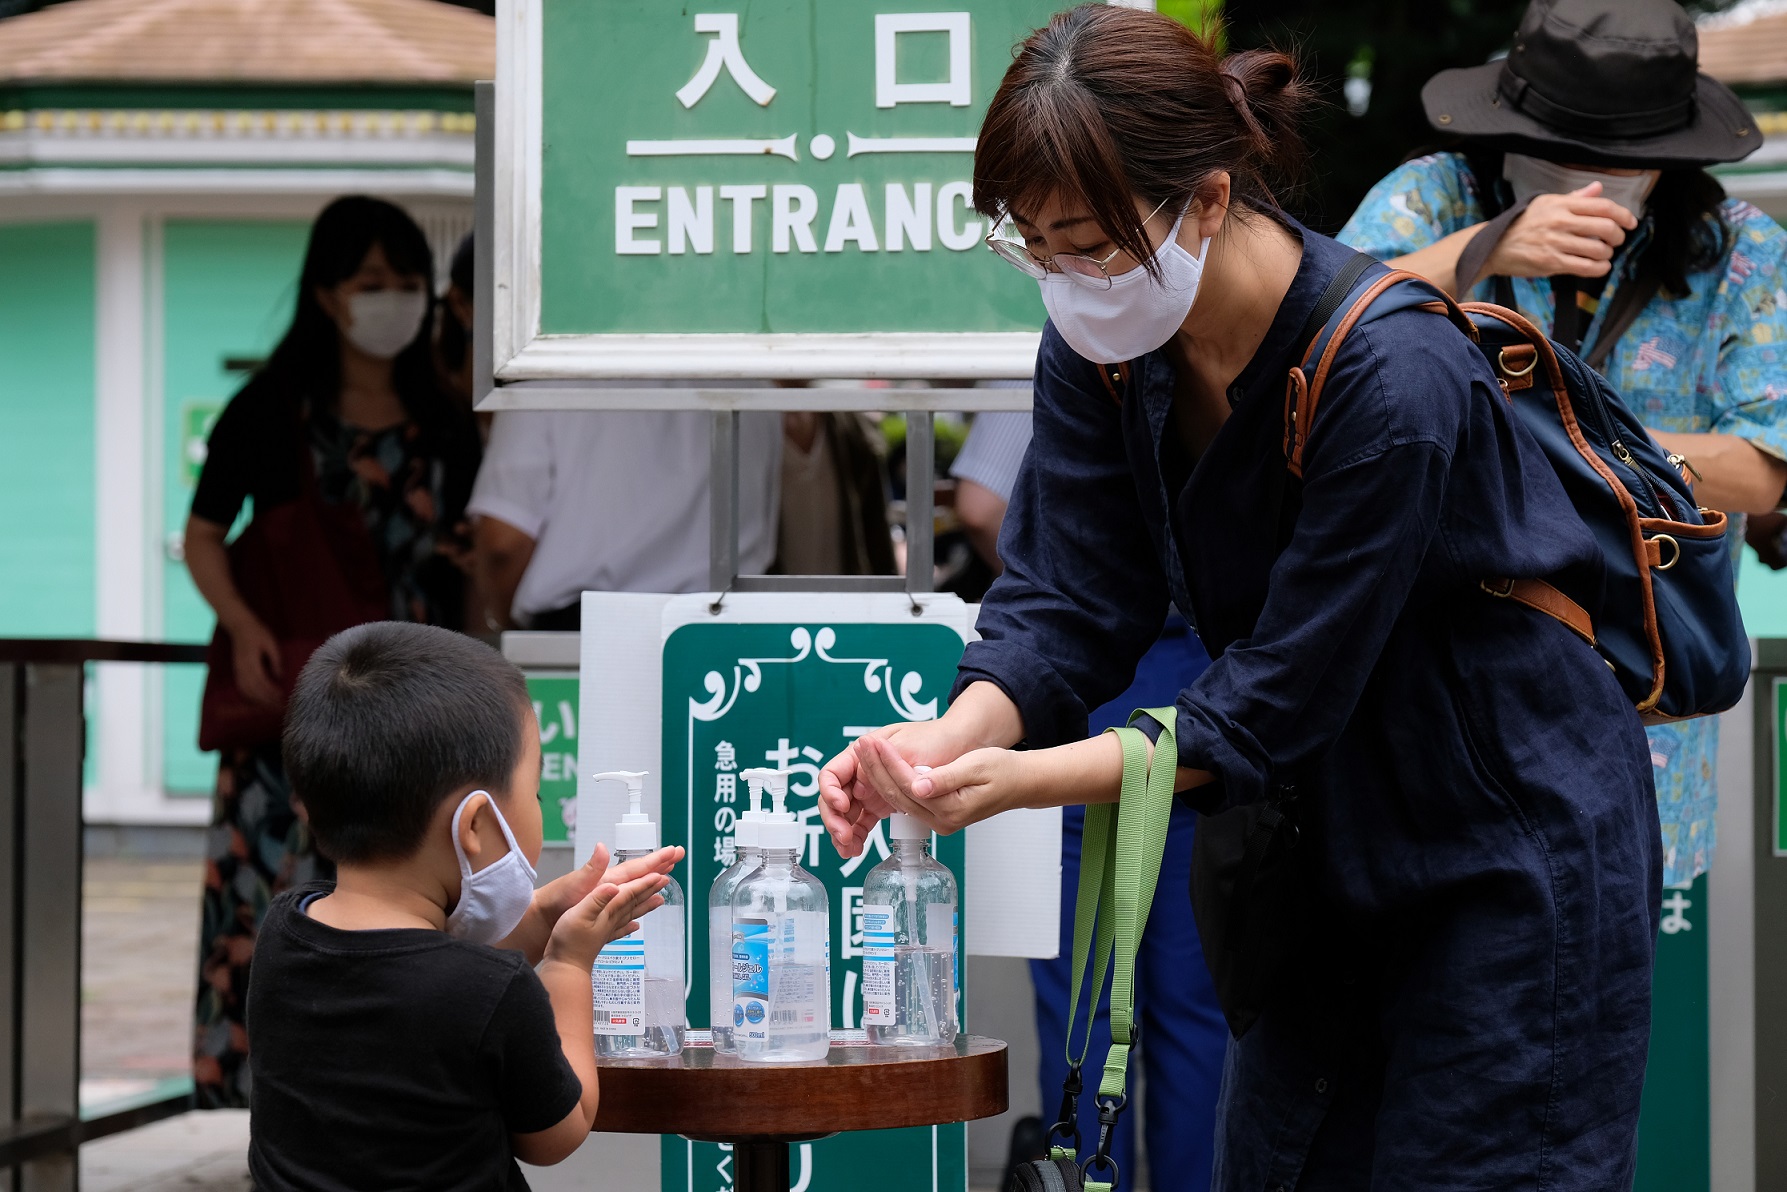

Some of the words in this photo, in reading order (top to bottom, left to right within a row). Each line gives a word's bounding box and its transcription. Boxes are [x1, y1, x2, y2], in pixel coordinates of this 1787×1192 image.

[675, 12, 972, 109] 入口
[713, 740, 738, 881] 急用の場
